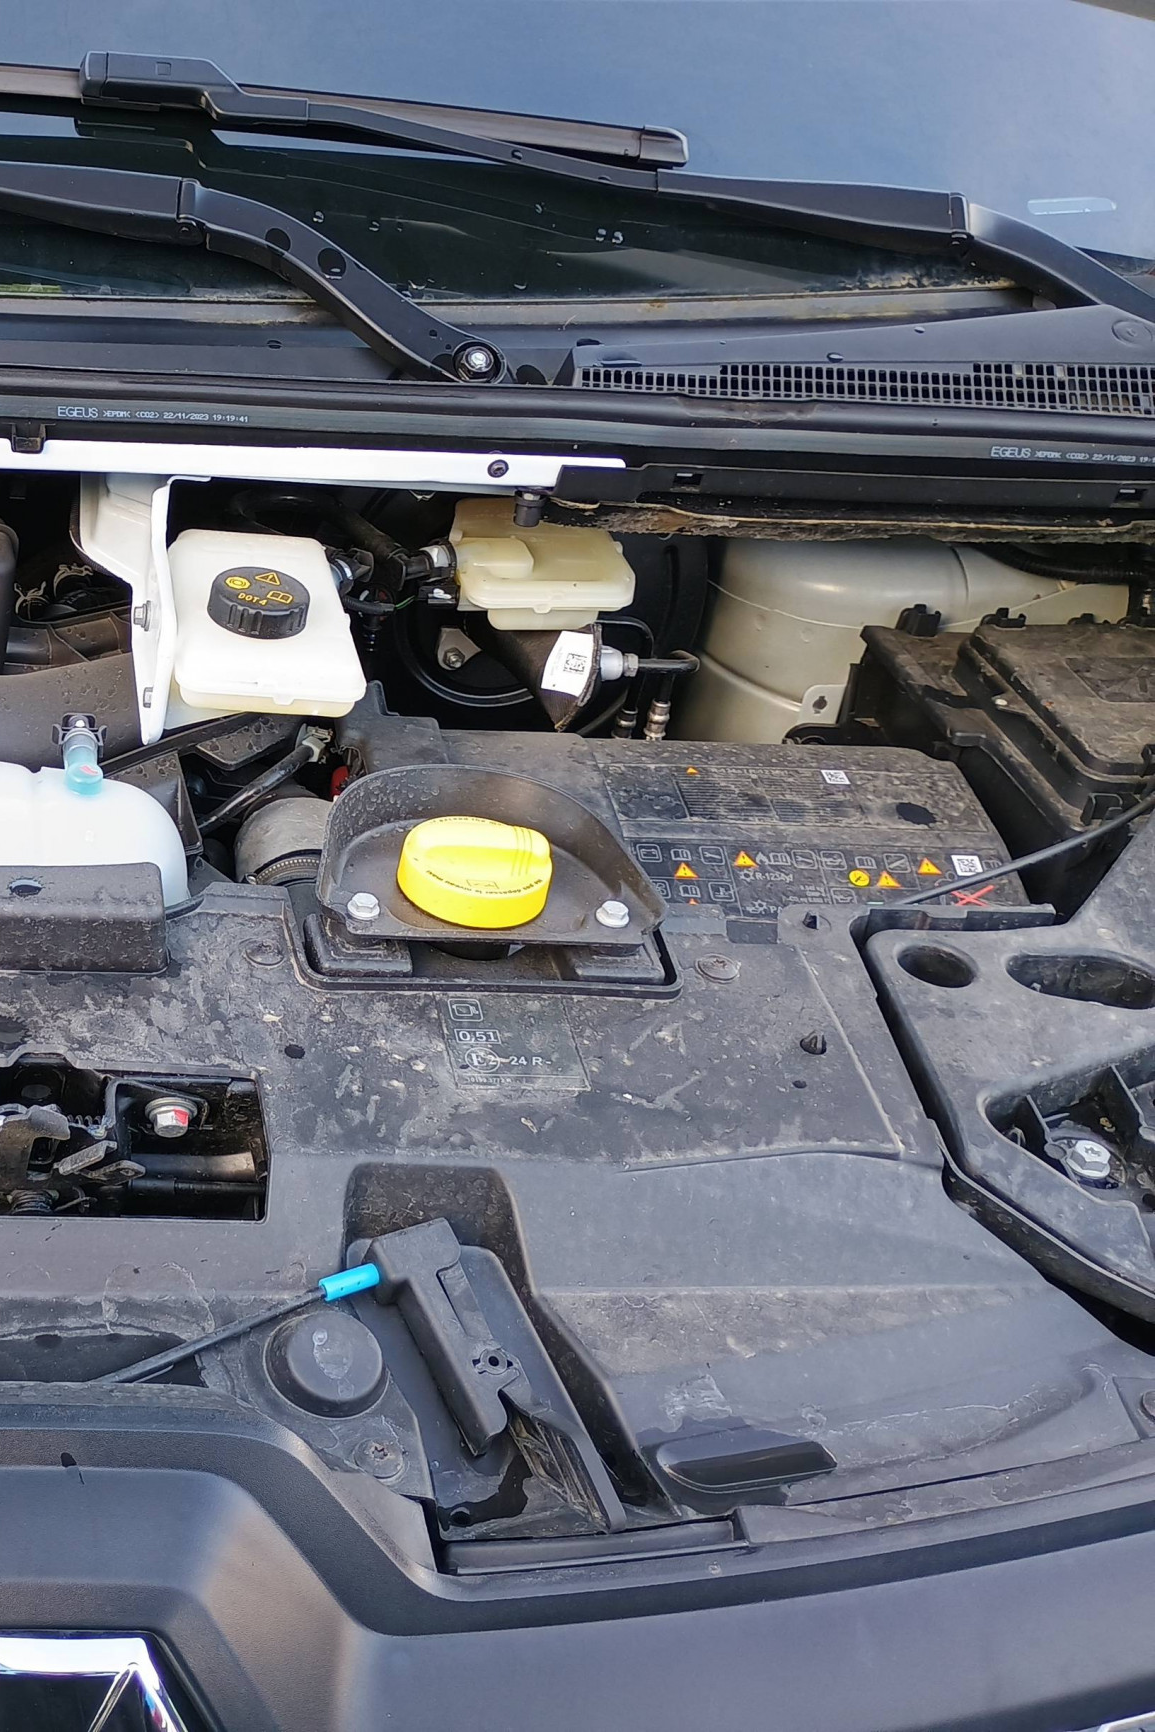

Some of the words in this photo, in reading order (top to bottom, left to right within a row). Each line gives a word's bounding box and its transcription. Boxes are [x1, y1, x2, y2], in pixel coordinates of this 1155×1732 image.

[57, 406, 99, 418] EGEUS
[163, 411, 209, 421] 22/11/2023
[212, 414, 249, 423] 19:19:41
[990, 446, 1032, 459] EGEUS
[238, 592, 258, 603] DOT
[459, 1031, 498, 1043] 0,51
[509, 1056, 528, 1066] 24
